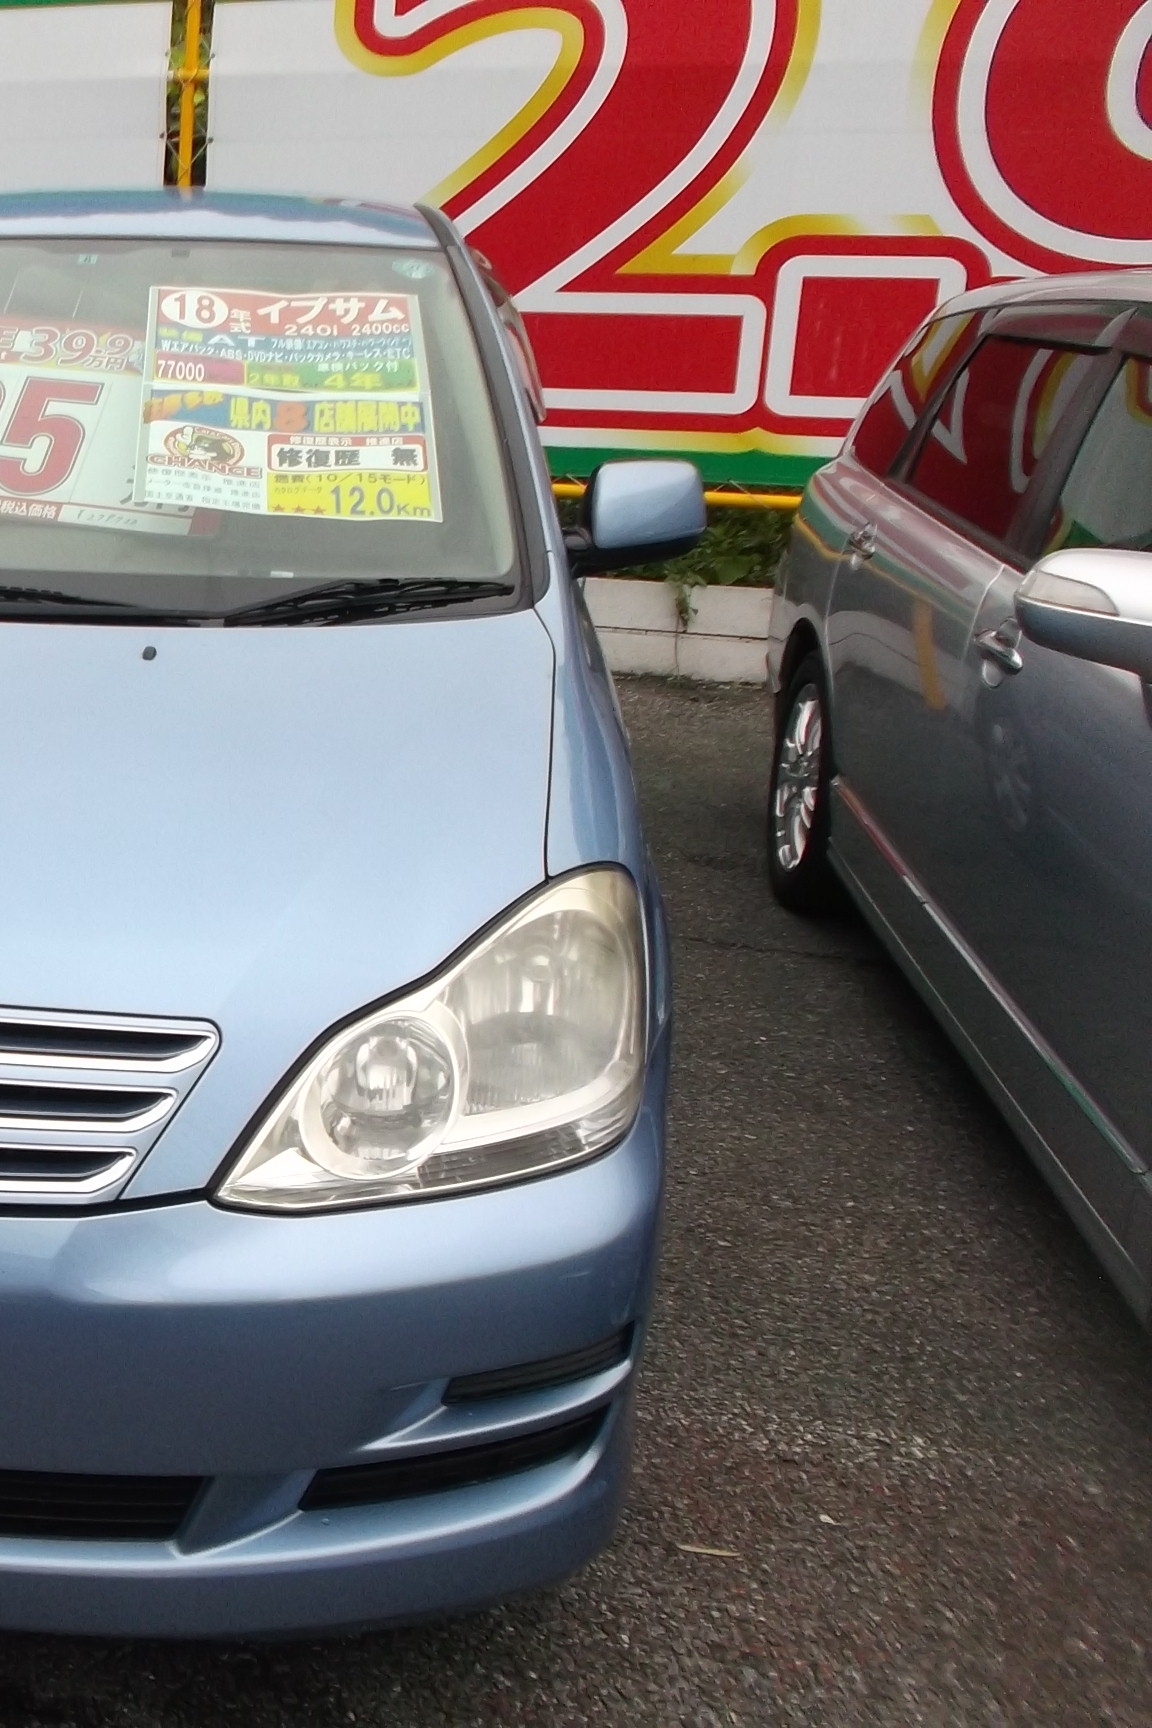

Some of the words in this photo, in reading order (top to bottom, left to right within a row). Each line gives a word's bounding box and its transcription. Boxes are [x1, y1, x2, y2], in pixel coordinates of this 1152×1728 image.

[157, 359, 206, 383] 77000
[276, 447, 361, 468] 修復歴
